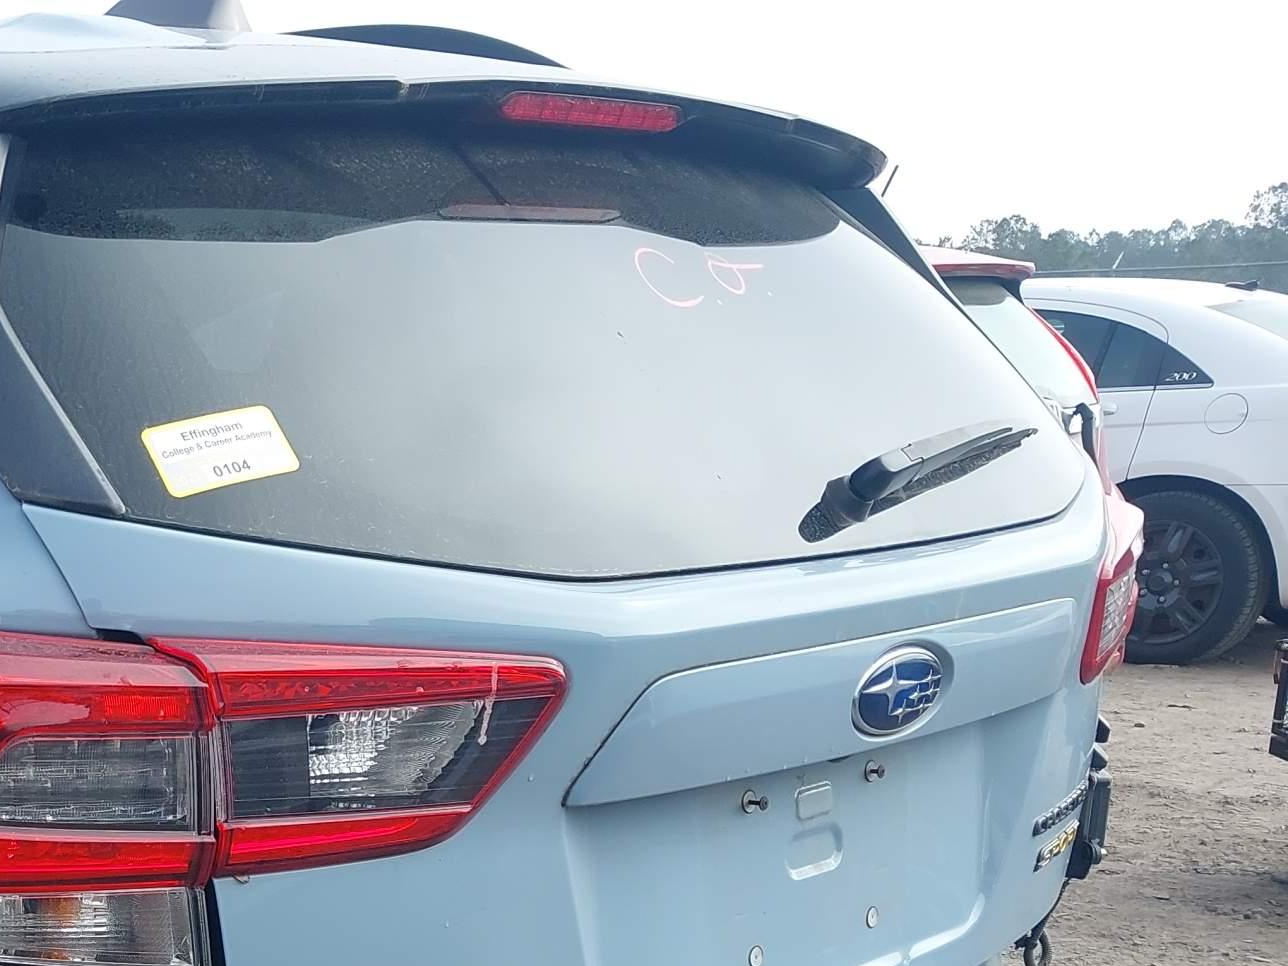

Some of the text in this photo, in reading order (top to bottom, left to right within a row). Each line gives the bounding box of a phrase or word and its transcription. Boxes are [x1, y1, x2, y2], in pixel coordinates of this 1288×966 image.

[1165, 372, 1197, 382] 200
[180, 422, 243, 442] Effingham
[161, 429, 273, 460] College & Career Academy
[212, 459, 252, 477] 0104
